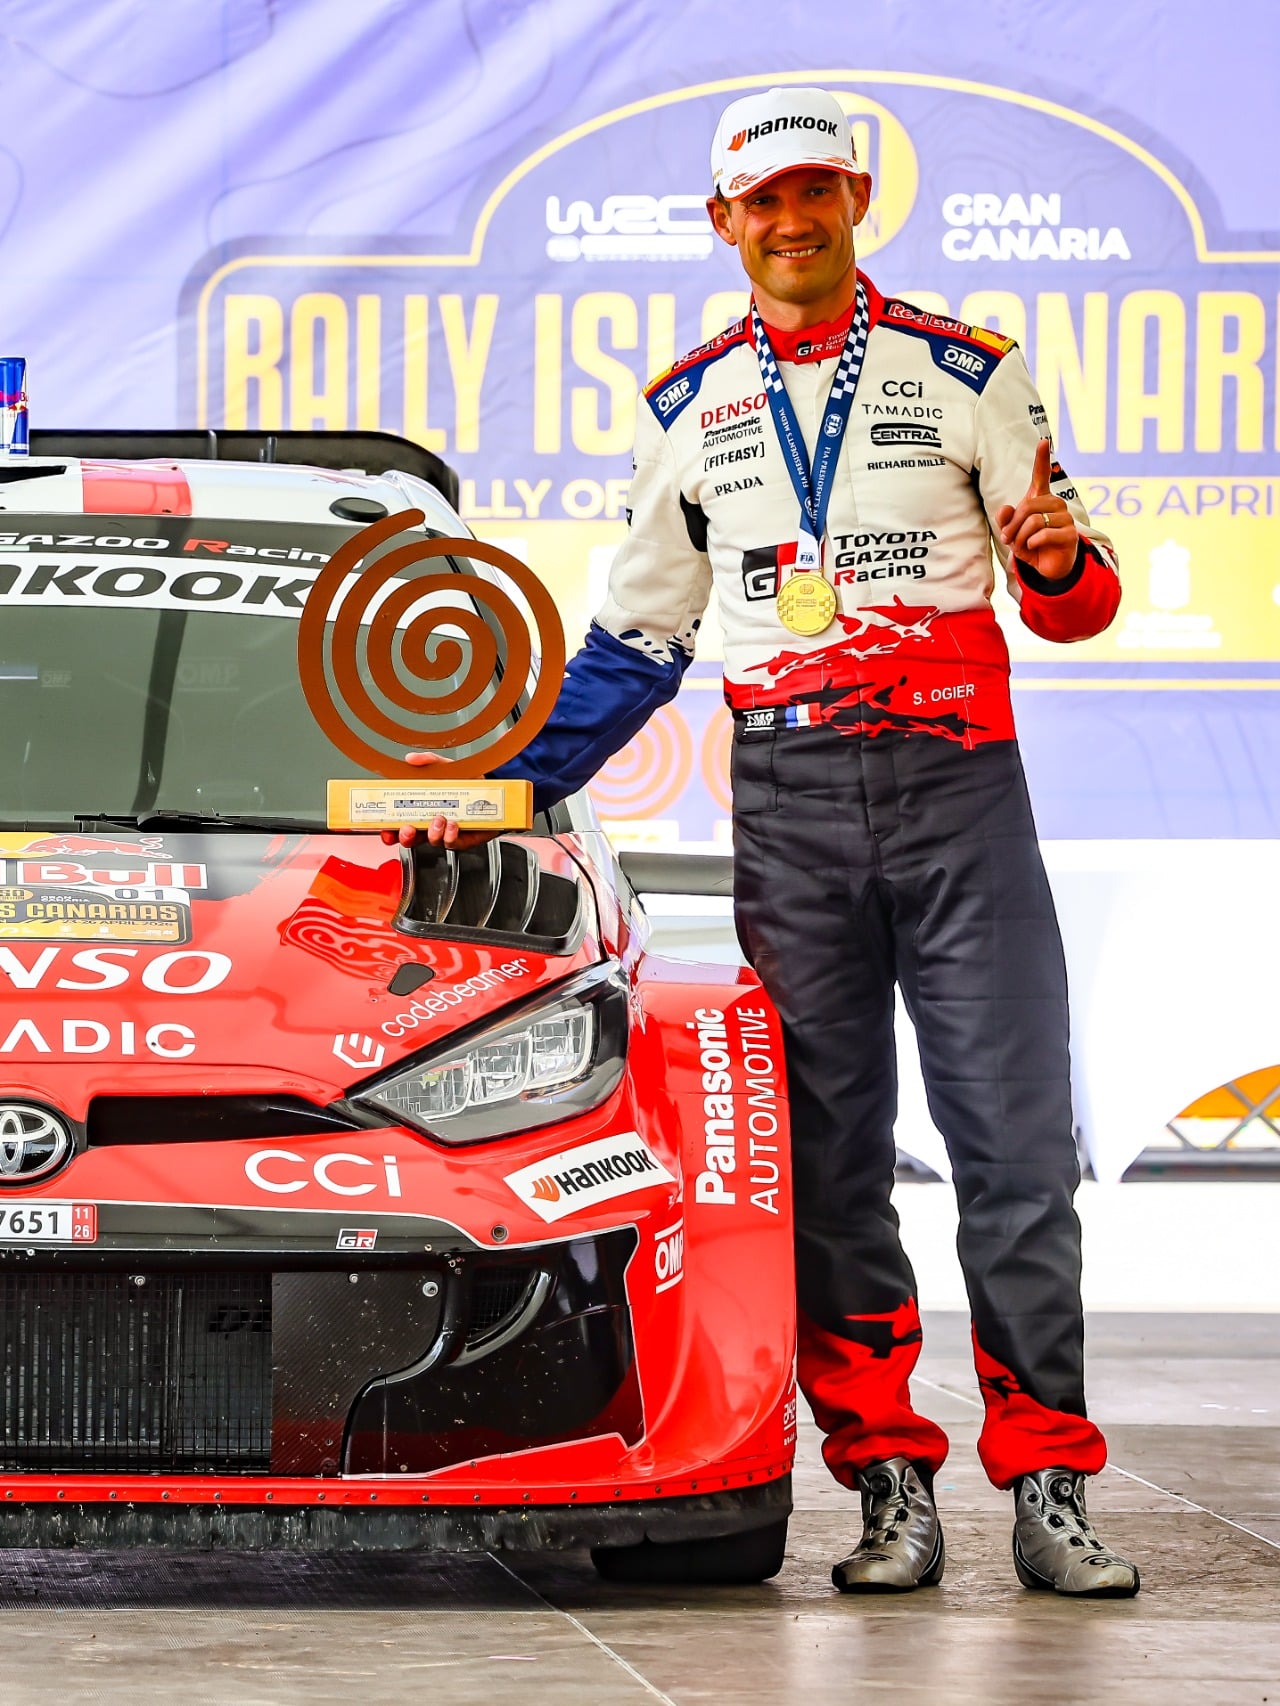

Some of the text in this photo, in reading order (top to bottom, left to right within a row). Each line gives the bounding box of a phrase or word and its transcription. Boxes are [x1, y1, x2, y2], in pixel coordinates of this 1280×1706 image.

[941, 193, 1061, 226] GRAN
[941, 227, 1132, 262] CANARIA
[888, 303, 929, 326] Red
[798, 344, 822, 356] GR
[944, 349, 984, 374] OMP
[224, 292, 500, 454] RALLY
[658, 380, 690, 412] OMP
[700, 393, 768, 430] DENSO
[779, 407, 790, 432] MEDAL
[861, 404, 943, 419] TAMADIC
[702, 425, 763, 449] AUTOMOTIVE
[704, 416, 761, 439] Panasonic
[870, 429, 941, 441] CENTRAL
[867, 457, 946, 471] RICHARD MILLE
[714, 476, 764, 496] PRADA
[461, 479, 552, 519] LLY
[561, 479, 632, 519] OF
[833, 530, 937, 550] TOYOTA
[184, 538, 345, 566] Racin
[800, 553, 815, 563] FIA
[835, 547, 928, 568] GAZOO
[834, 563, 926, 586] Racing
[913, 683, 976, 705] S. OGIER
[18, 861, 207, 888] Bull
[26, 903, 178, 921] CANARIAS
[381, 958, 528, 1038] codebeamer
[686, 1008, 736, 1205] Panasonic
[736, 1007, 780, 1215] AUTOMOTIVE
[74, 1208, 89, 1220] 11
[74, 1225, 90, 1239] 26
[339, 1234, 376, 1249] GR
[655, 1230, 684, 1281] OMP
